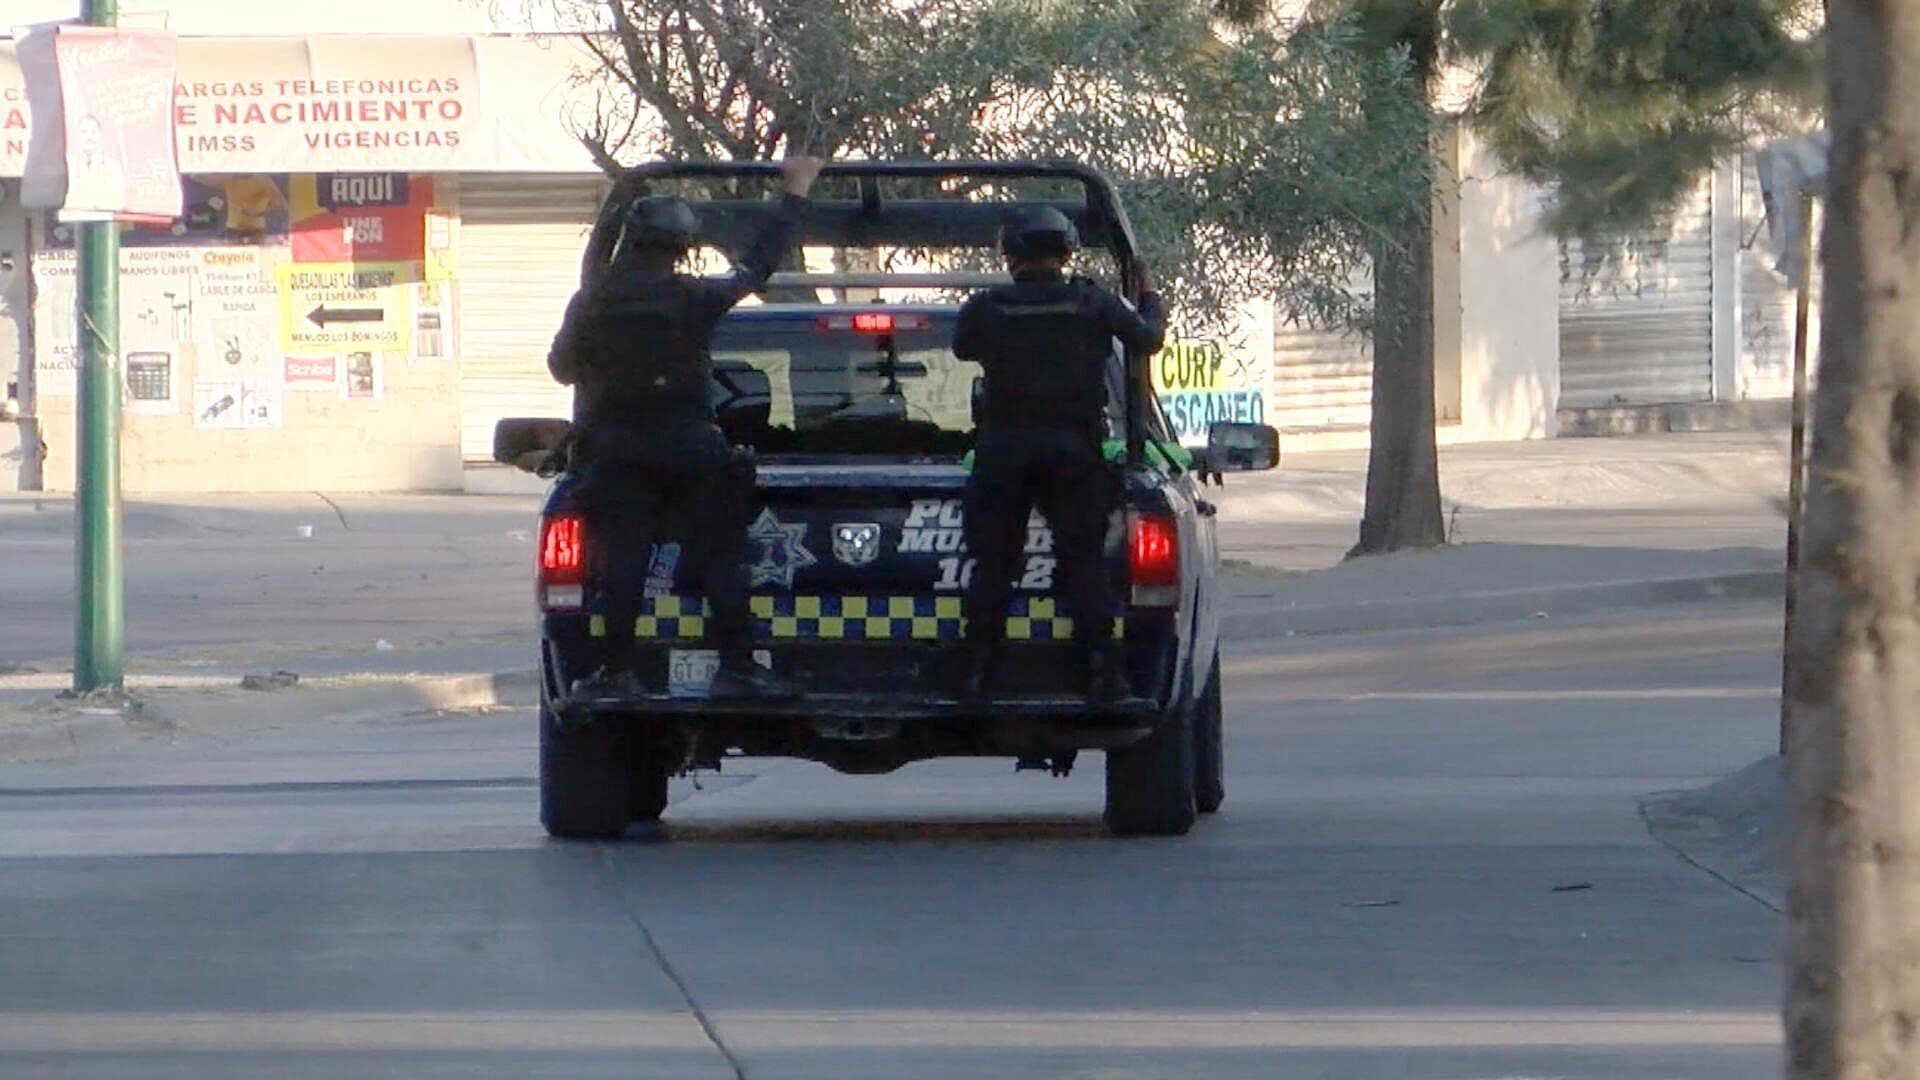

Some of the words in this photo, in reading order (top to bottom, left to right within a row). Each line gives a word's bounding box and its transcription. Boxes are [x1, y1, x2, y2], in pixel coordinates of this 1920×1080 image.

[174, 80, 264, 98] ARGAS
[175, 104, 198, 125] E
[214, 99, 464, 125] NACIMIENTO
[187, 135, 257, 152] IMSS
[303, 130, 462, 150] VIGENCIAS
